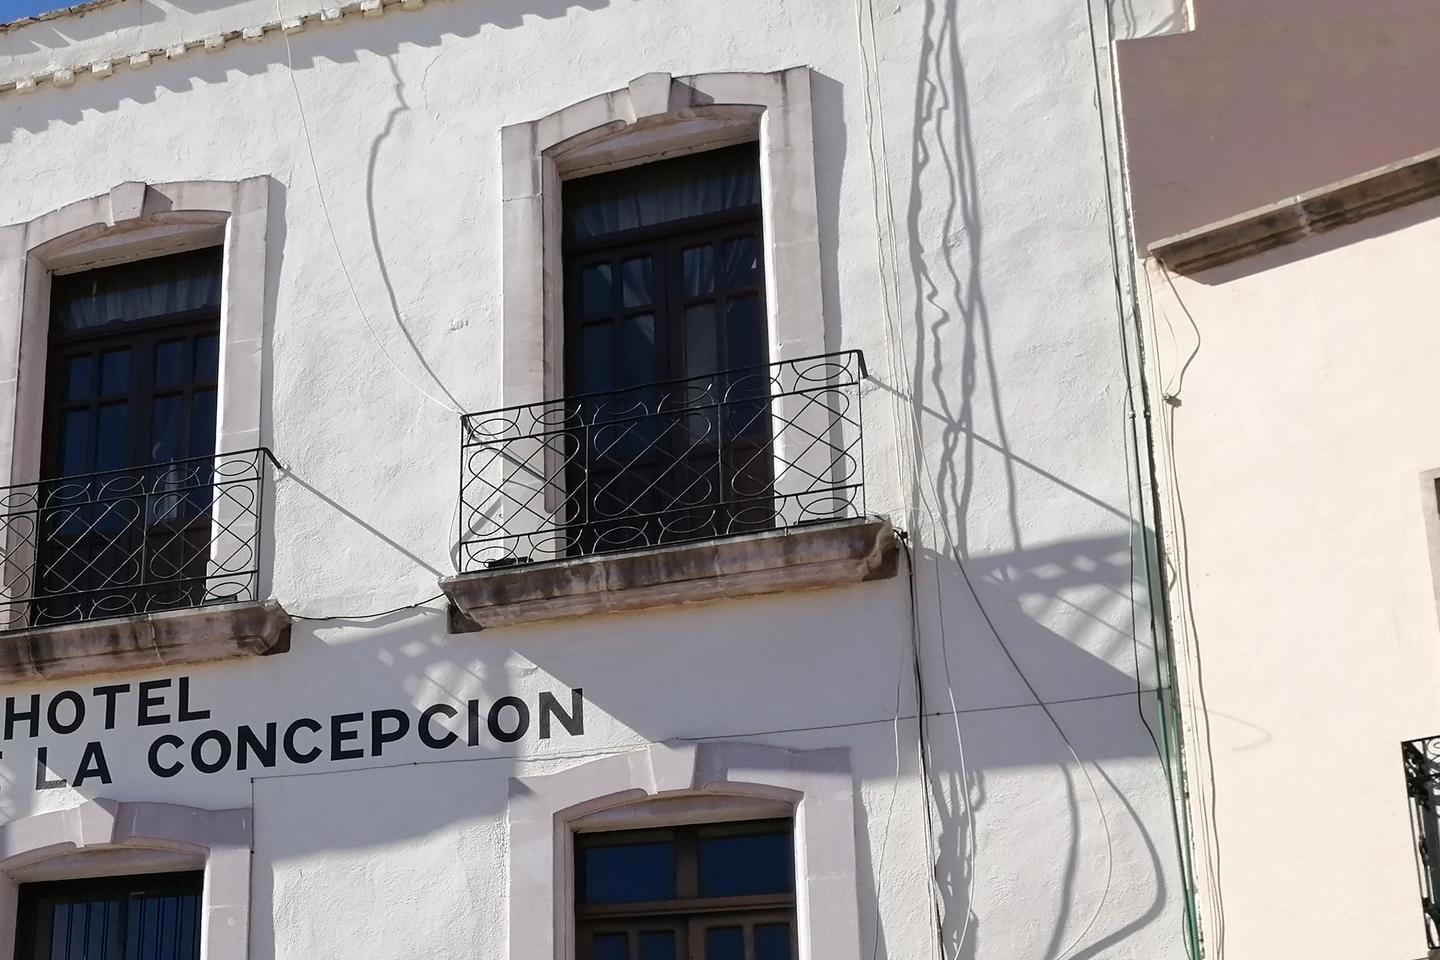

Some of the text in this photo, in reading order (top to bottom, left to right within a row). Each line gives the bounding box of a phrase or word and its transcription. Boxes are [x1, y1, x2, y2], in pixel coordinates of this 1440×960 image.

[3, 676, 211, 741] HOTEL
[33, 741, 112, 790] LA
[148, 688, 585, 778] CONCEPCION
